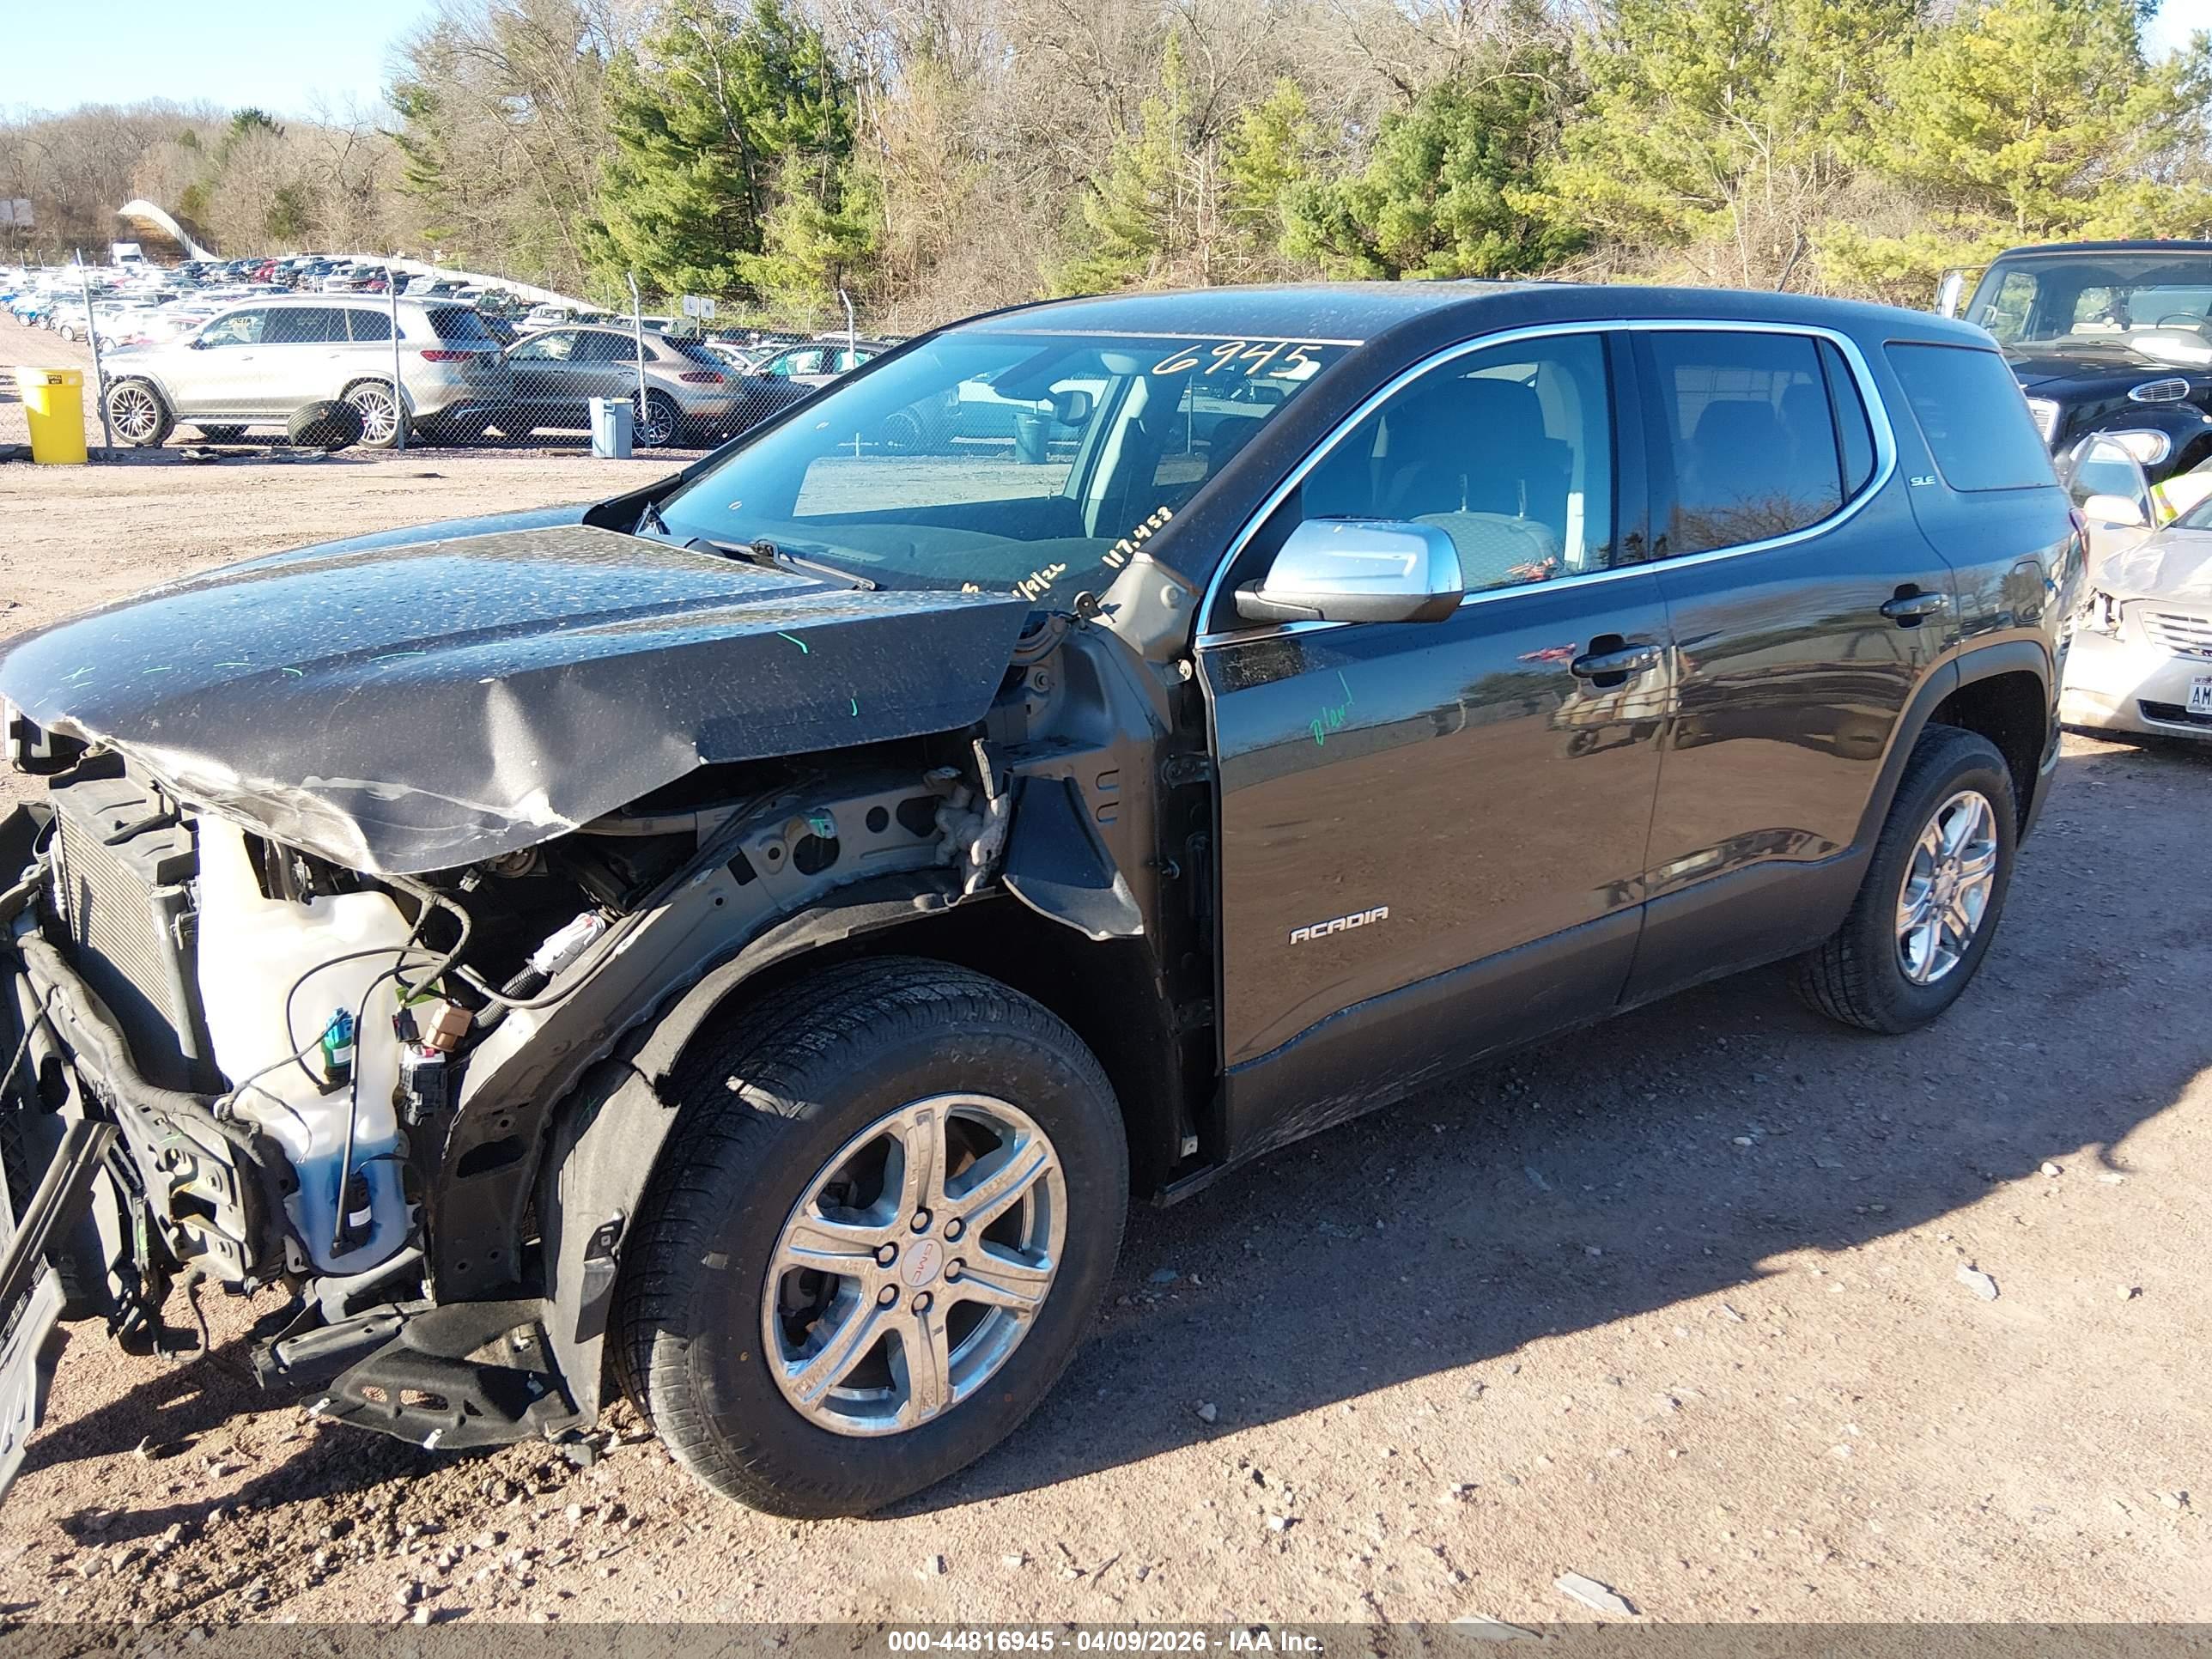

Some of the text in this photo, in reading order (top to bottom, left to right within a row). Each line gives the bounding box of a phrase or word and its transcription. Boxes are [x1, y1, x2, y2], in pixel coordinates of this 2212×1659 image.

[1152, 341, 1322, 376] 6945
[1911, 475, 1936, 487] SLE
[1290, 906, 1389, 945] ACADIA
[911, 1243, 933, 1284] GMC
